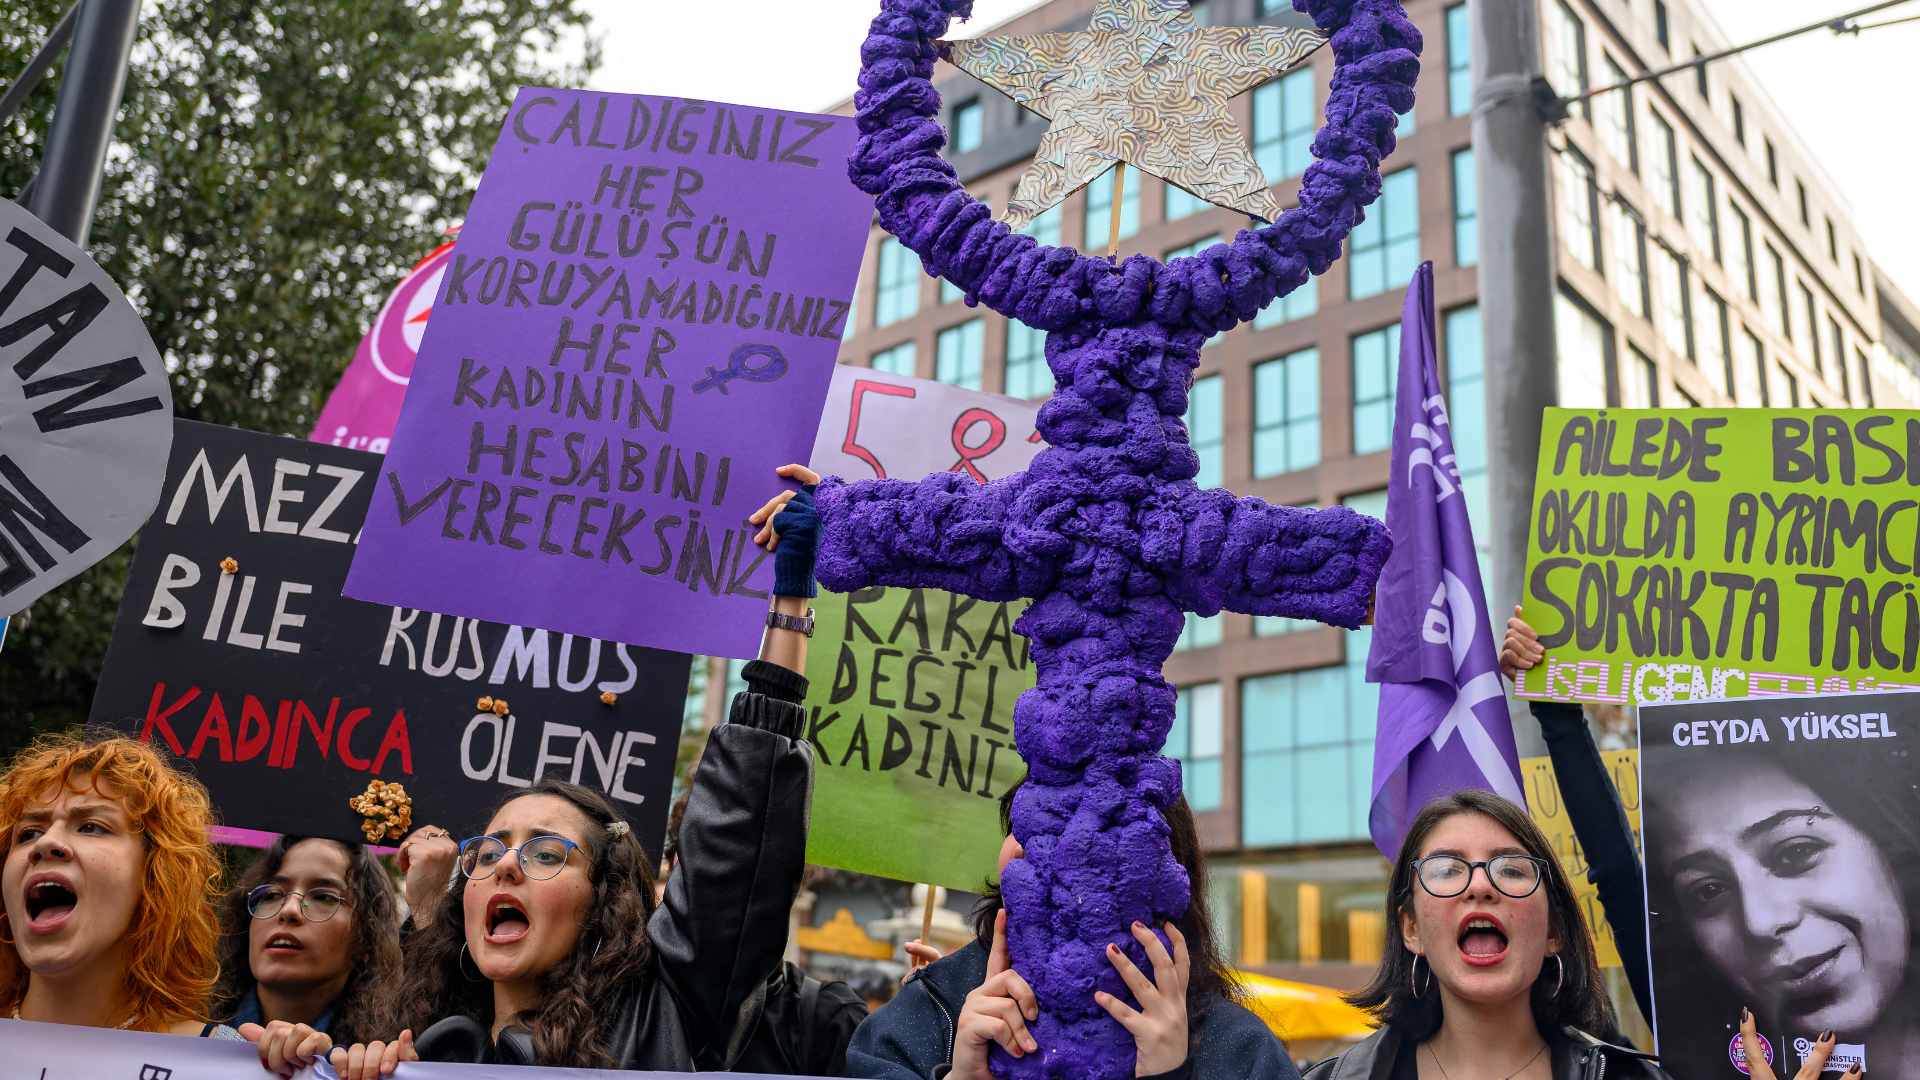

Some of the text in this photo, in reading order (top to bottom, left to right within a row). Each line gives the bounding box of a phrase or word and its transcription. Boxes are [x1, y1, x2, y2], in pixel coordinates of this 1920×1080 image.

[592, 163, 704, 219] HER
[506, 200, 777, 278] GÜLÜŞÜN
[443, 253, 851, 340] KORUYAMADIĞINIZ
[549, 316, 677, 378] HER
[453, 357, 675, 433] KADININ
[467, 421, 730, 506] HESABINI
[1552, 411, 1728, 481] AİLEDE
[1537, 489, 1695, 560] OKULDA
[142, 554, 312, 654] BİLE
[1529, 557, 1779, 662] SOKAKTA
[831, 642, 1010, 734] DEĞİL
[140, 681, 413, 776] KADINCA
[1672, 710, 1897, 746] CEYDA YÜKSEL
